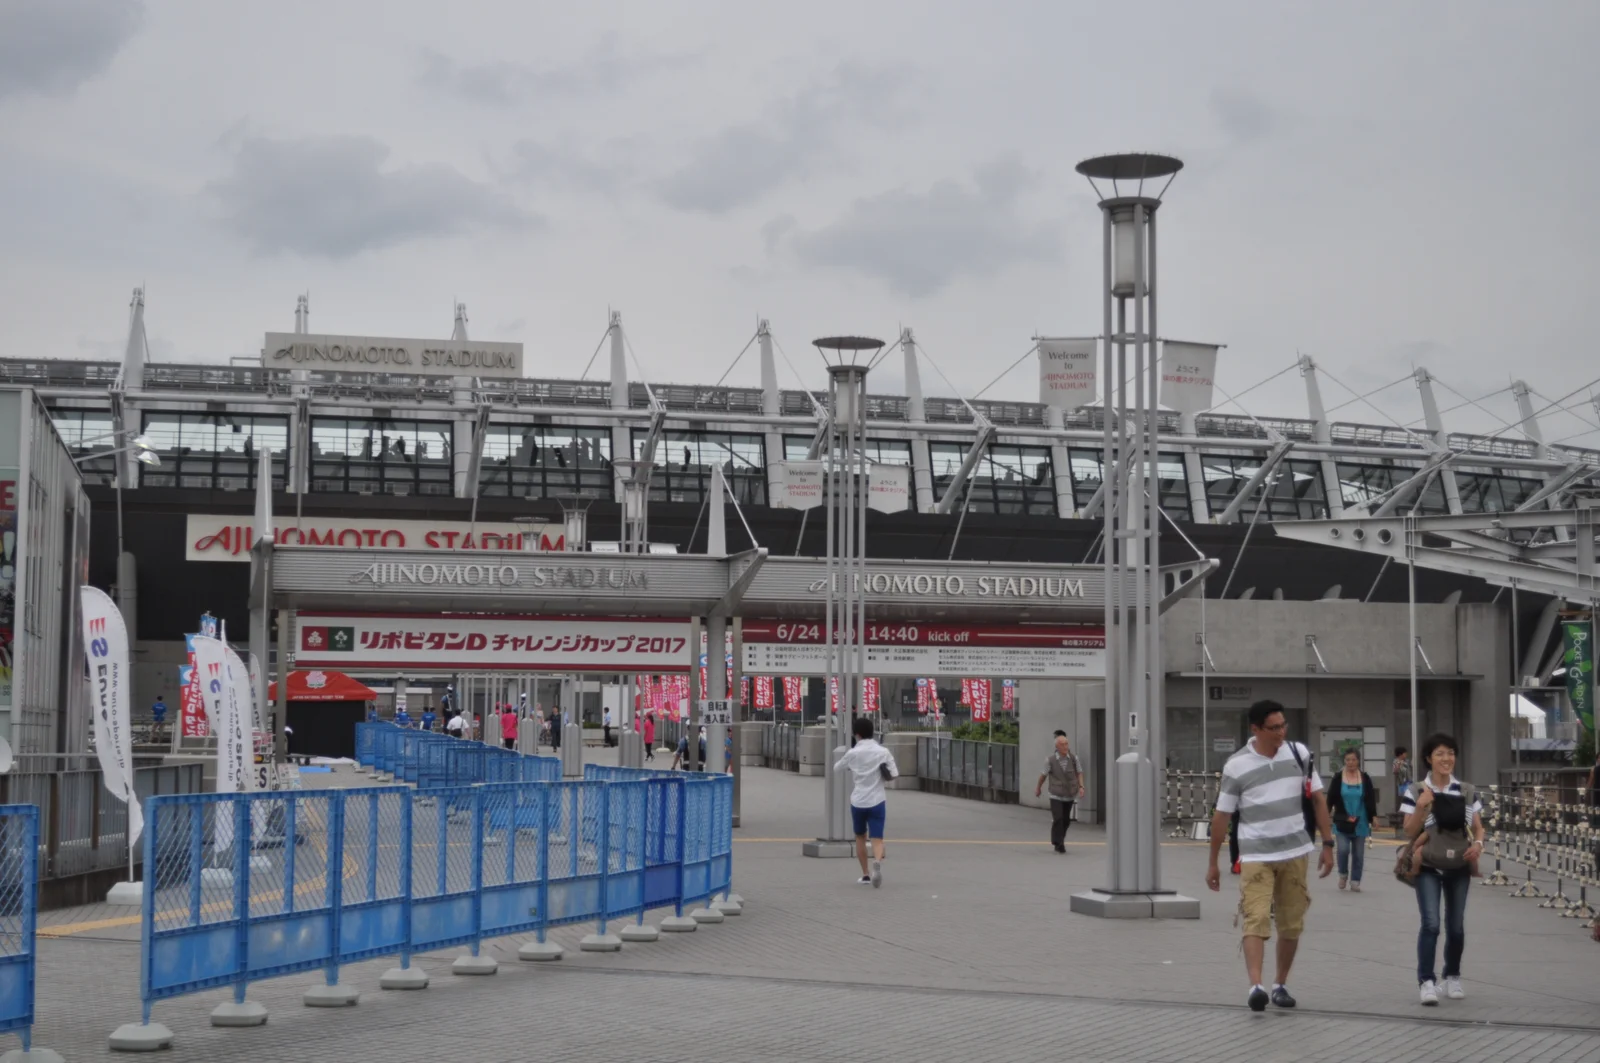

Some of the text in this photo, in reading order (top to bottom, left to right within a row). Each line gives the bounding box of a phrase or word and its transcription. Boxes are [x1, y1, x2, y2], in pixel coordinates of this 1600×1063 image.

[273, 343, 516, 369] AJINOMOTO STADIUM
[1048, 351, 1089, 361] Welcome
[1064, 361, 1073, 370] to
[1176, 365, 1200, 374] ようこそ
[1043, 372, 1095, 381] AJINOMOTO
[1049, 381, 1088, 390] STADIUM
[195, 526, 405, 555] AJIOMOTO
[350, 563, 648, 589] AJINOMOTO STADIUM
[978, 576, 1084, 597] STADIUM
[777, 624, 819, 641] 6/24
[869, 626, 918, 641] 14:40
[928, 631, 950, 642] kick
[954, 632, 969, 642] off
